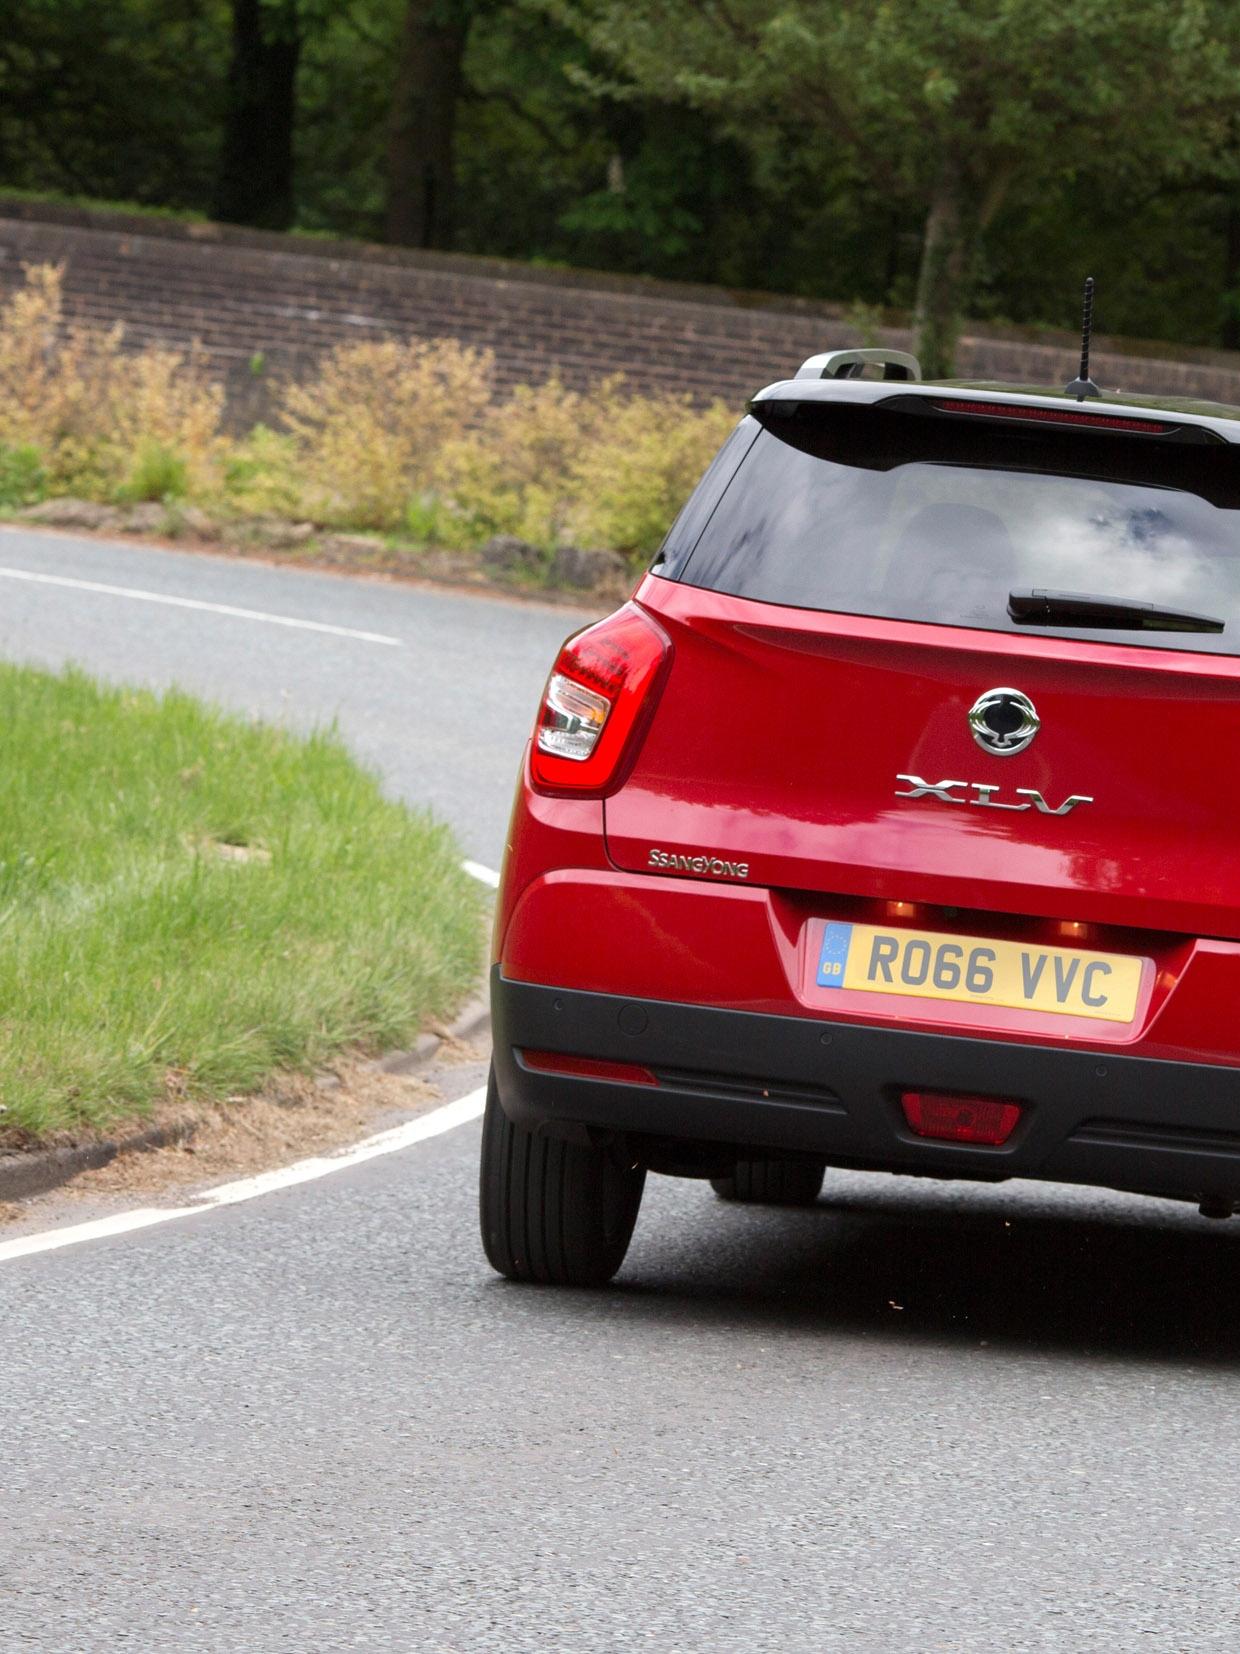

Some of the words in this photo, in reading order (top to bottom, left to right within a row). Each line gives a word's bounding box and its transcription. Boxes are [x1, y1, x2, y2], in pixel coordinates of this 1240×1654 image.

[895, 774, 1094, 815] XLV
[823, 961, 842, 976] GB
[867, 935, 996, 994] RO66
[1021, 952, 1113, 1008] VVC
